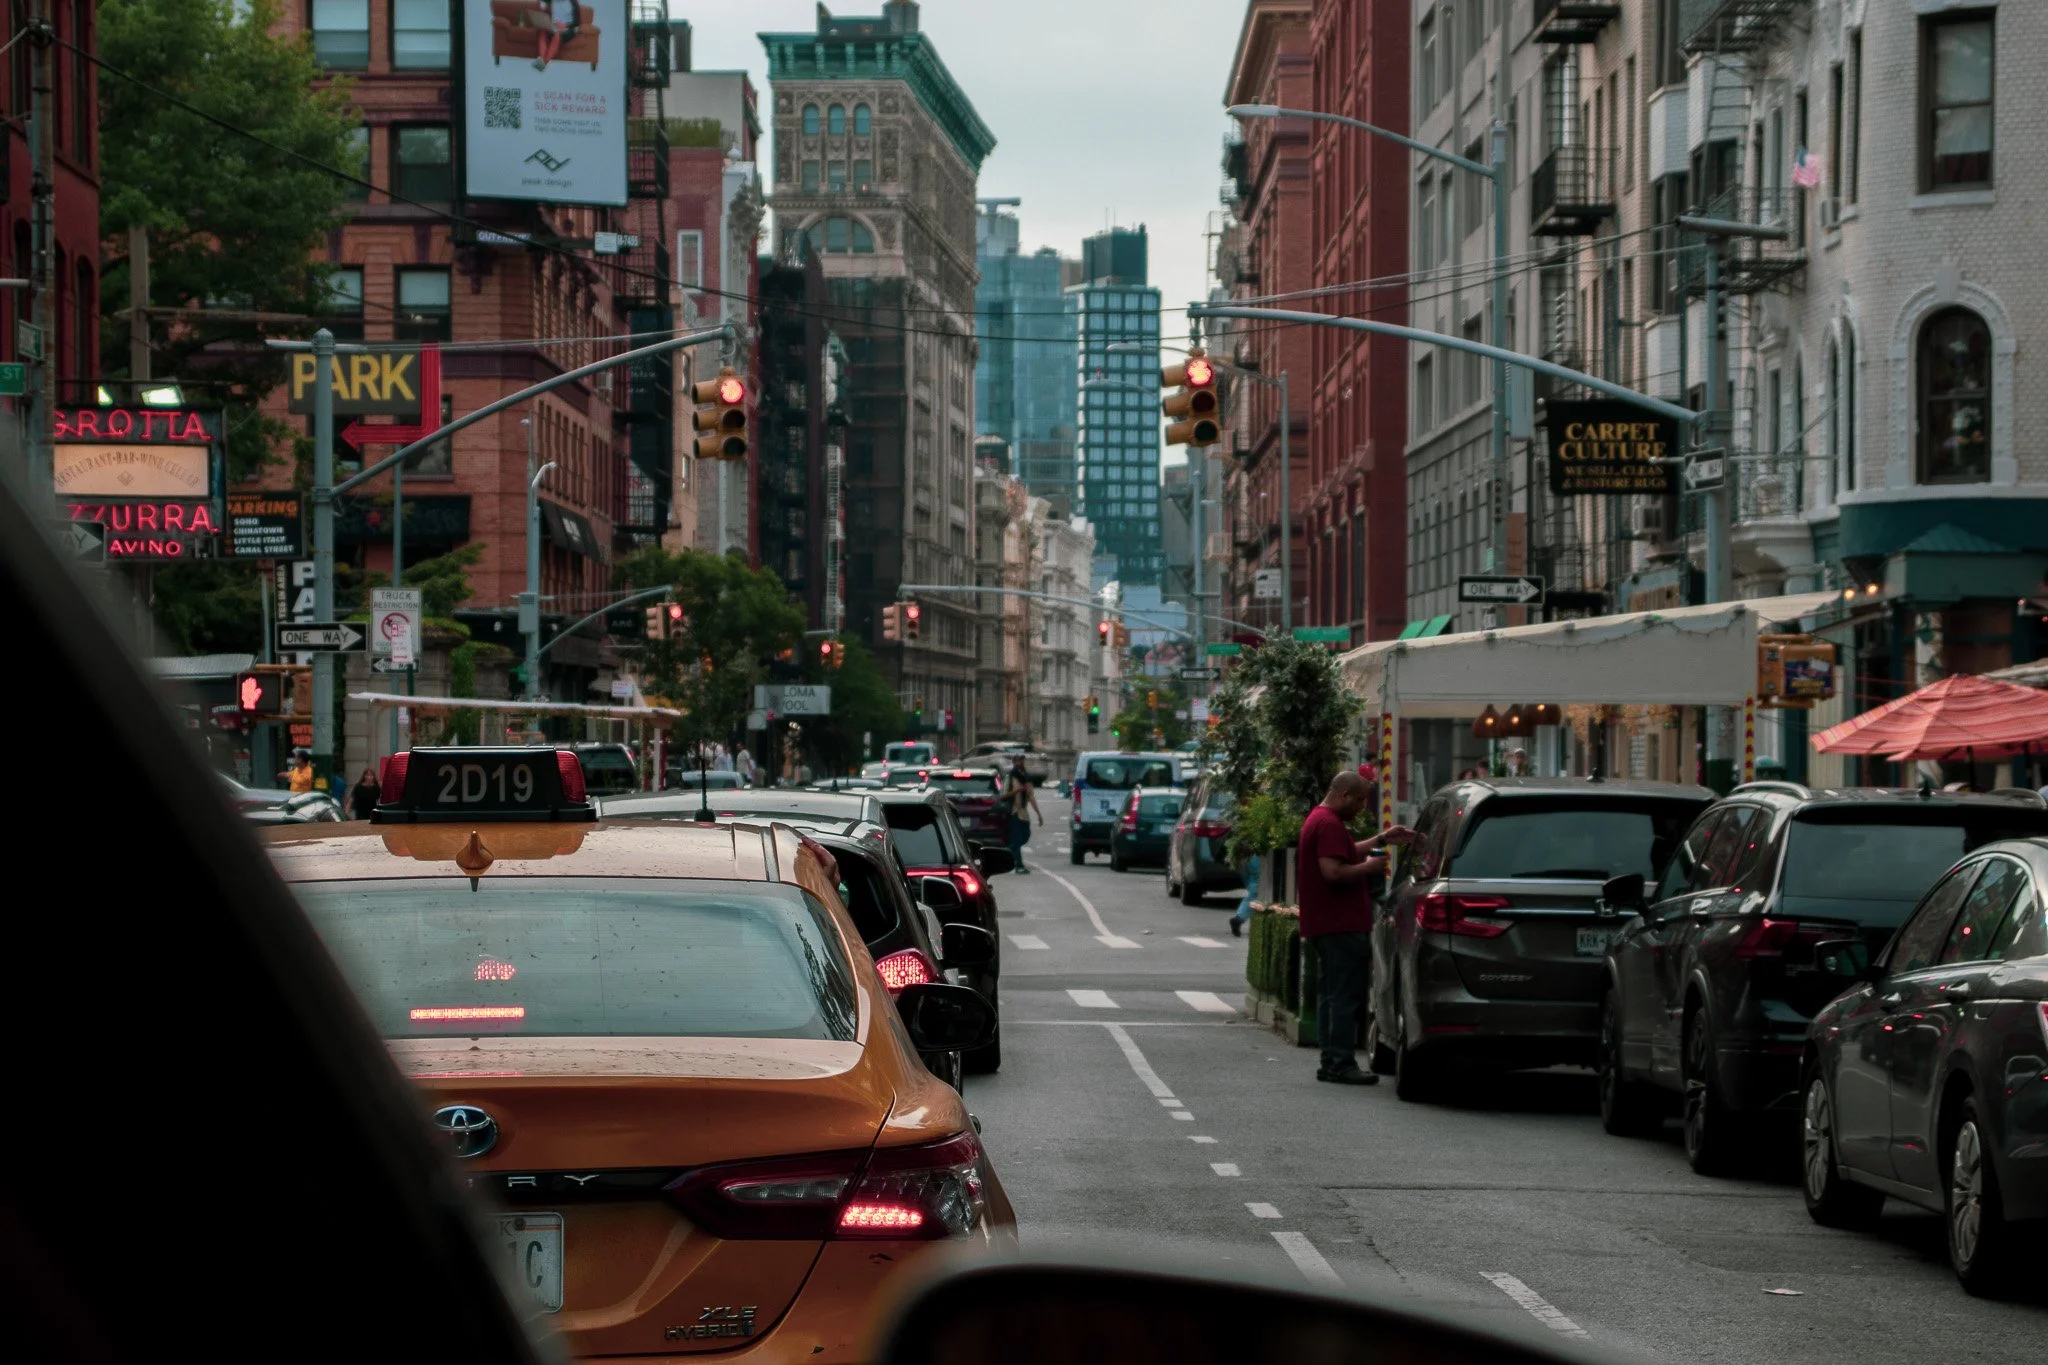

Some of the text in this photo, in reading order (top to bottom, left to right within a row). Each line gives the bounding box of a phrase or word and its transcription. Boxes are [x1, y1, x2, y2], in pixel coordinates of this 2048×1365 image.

[544, 91, 606, 103] SCAN FOR A
[535, 102, 558, 111] SICK
[545, 177, 573, 188] design
[2, 366, 22, 381] ST
[293, 353, 416, 401] PARK
[1565, 422, 1660, 441] CARPET
[1558, 441, 1667, 461] CULTURE
[1471, 583, 1530, 595] ONE WAY
[381, 591, 412, 600] TRUCK
[373, 601, 418, 609] RESTRICTION
[285, 631, 350, 643] ONE WAY
[783, 700, 809, 711] OOL
[437, 763, 535, 803] 2D19
[1479, 974, 1533, 982] ODYSSEY
[699, 1305, 758, 1320] XLE
[665, 1323, 739, 1340] HYBRID
